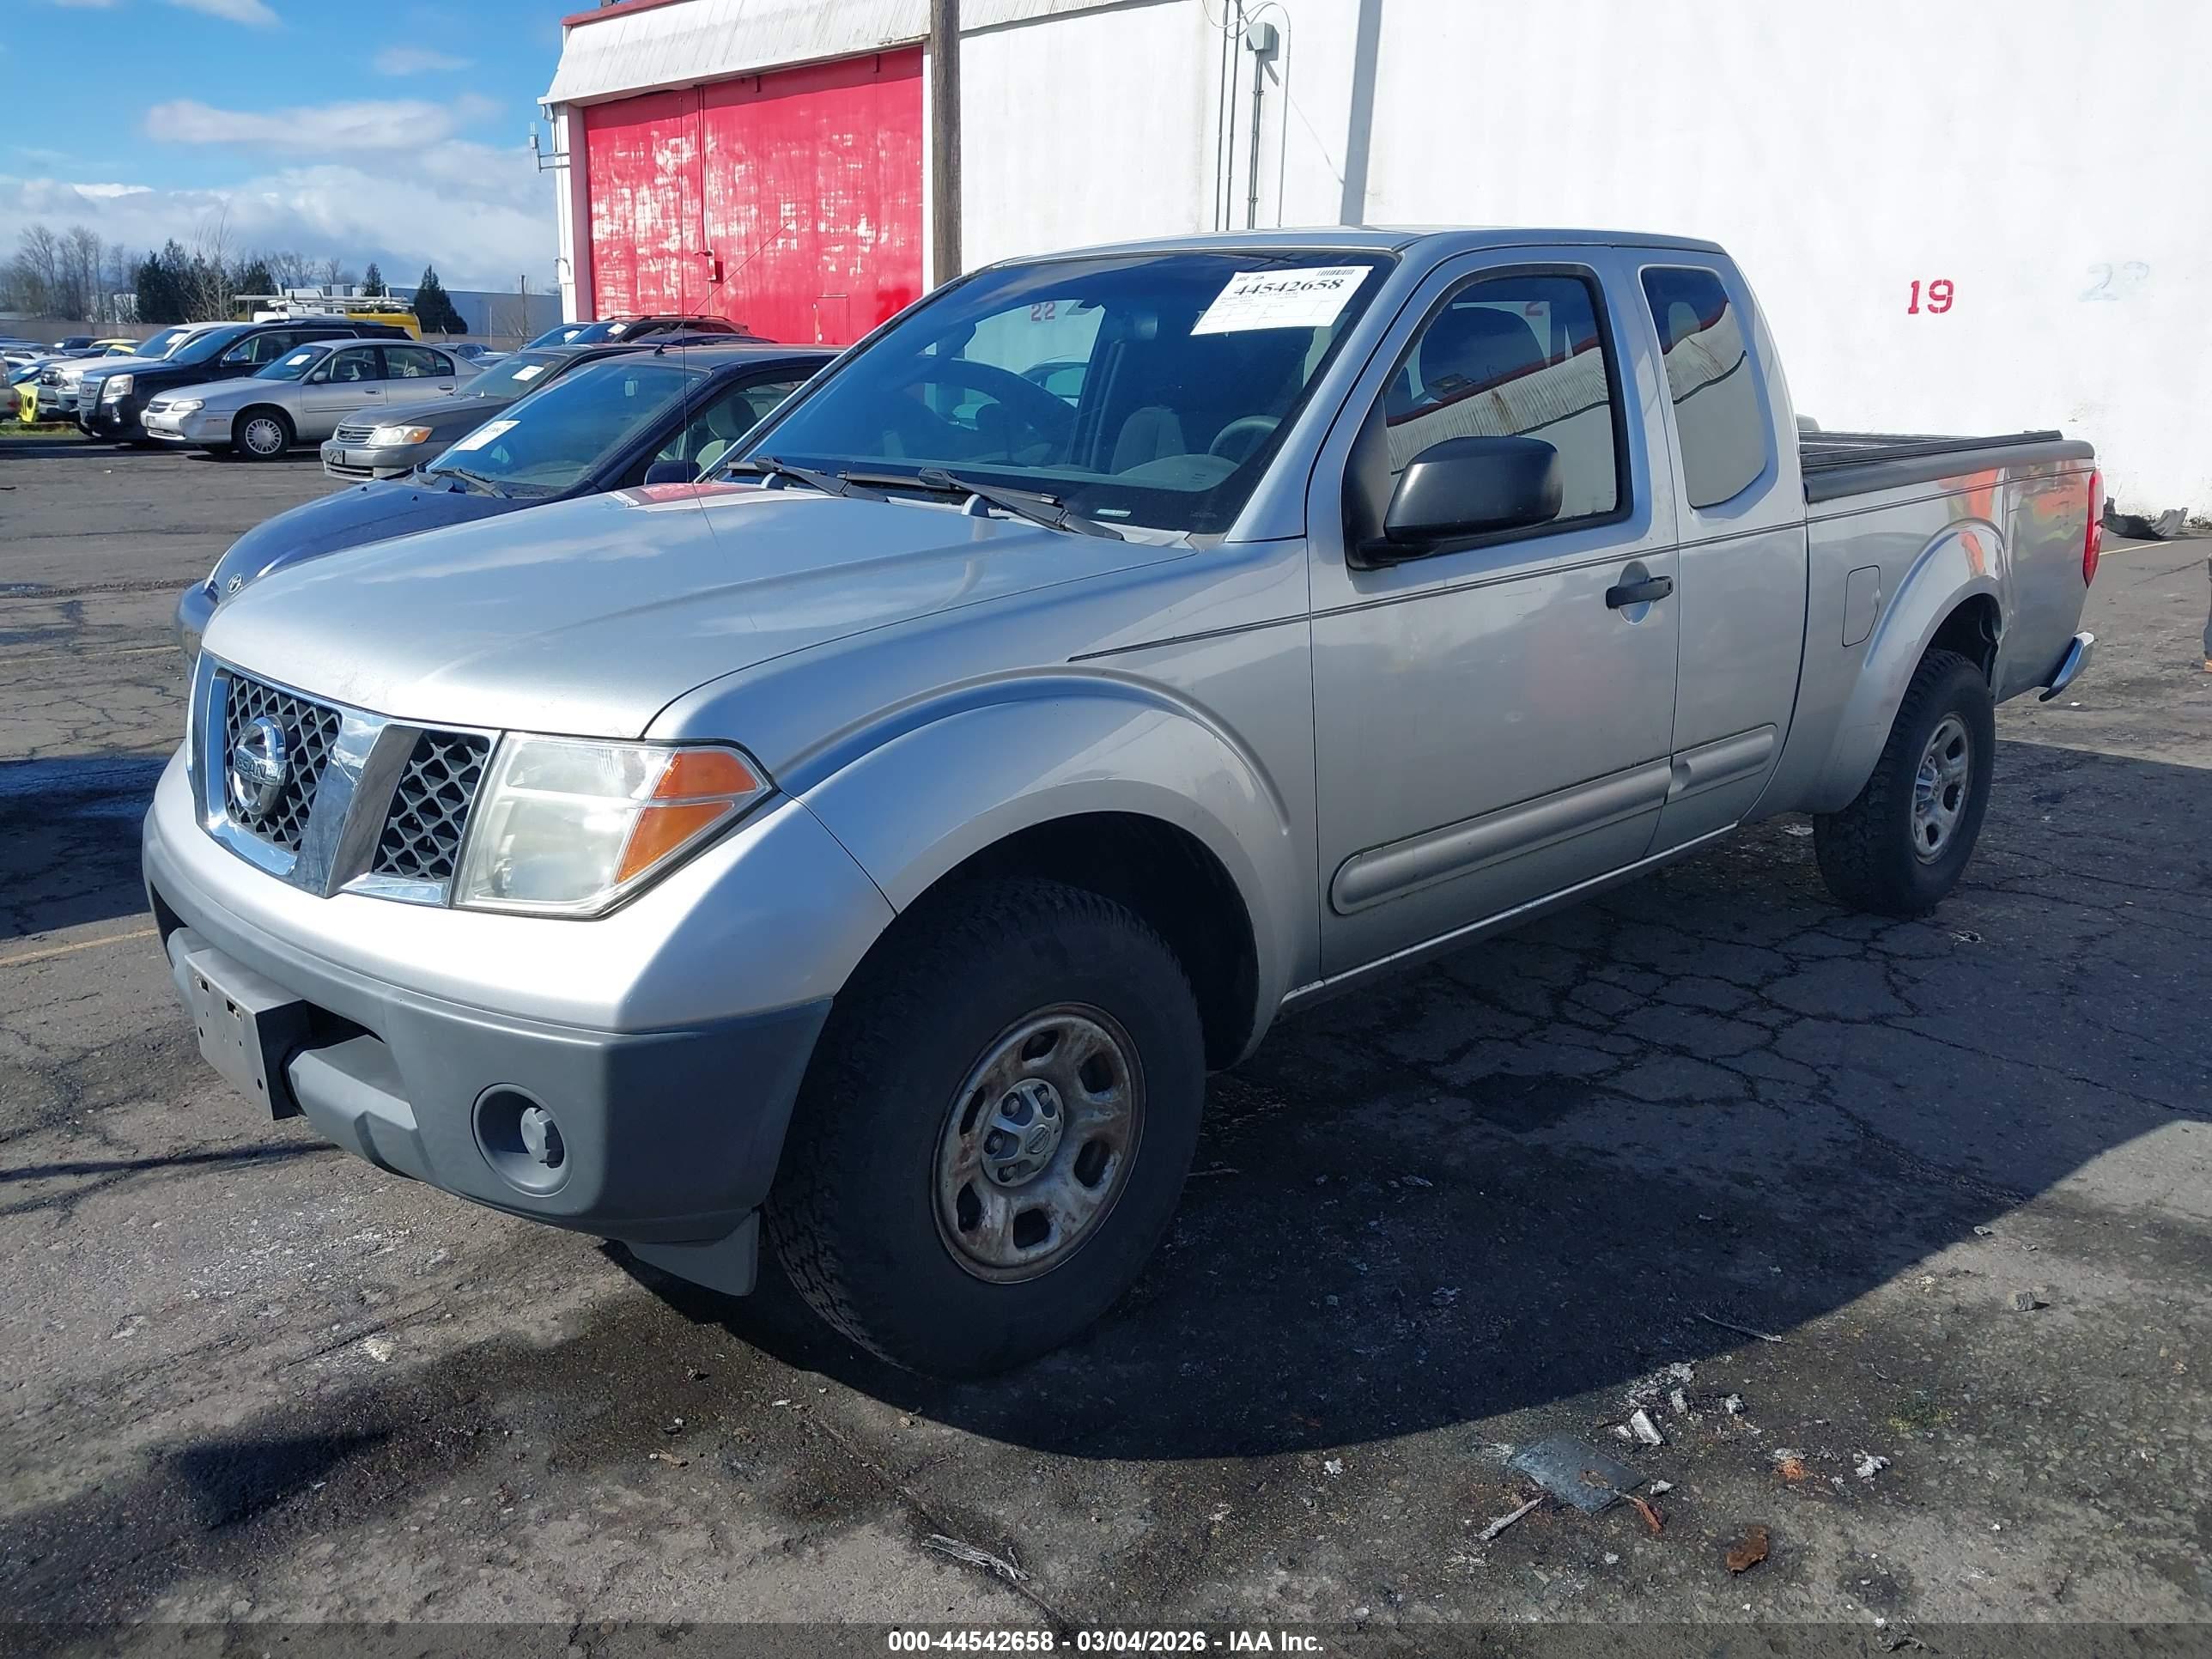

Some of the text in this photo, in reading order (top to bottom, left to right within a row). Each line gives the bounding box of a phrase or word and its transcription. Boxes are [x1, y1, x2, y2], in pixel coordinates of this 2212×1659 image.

[1233, 278, 1345, 296] 44542658
[1908, 279, 1954, 315] 19
[1030, 301, 1056, 322] 22
